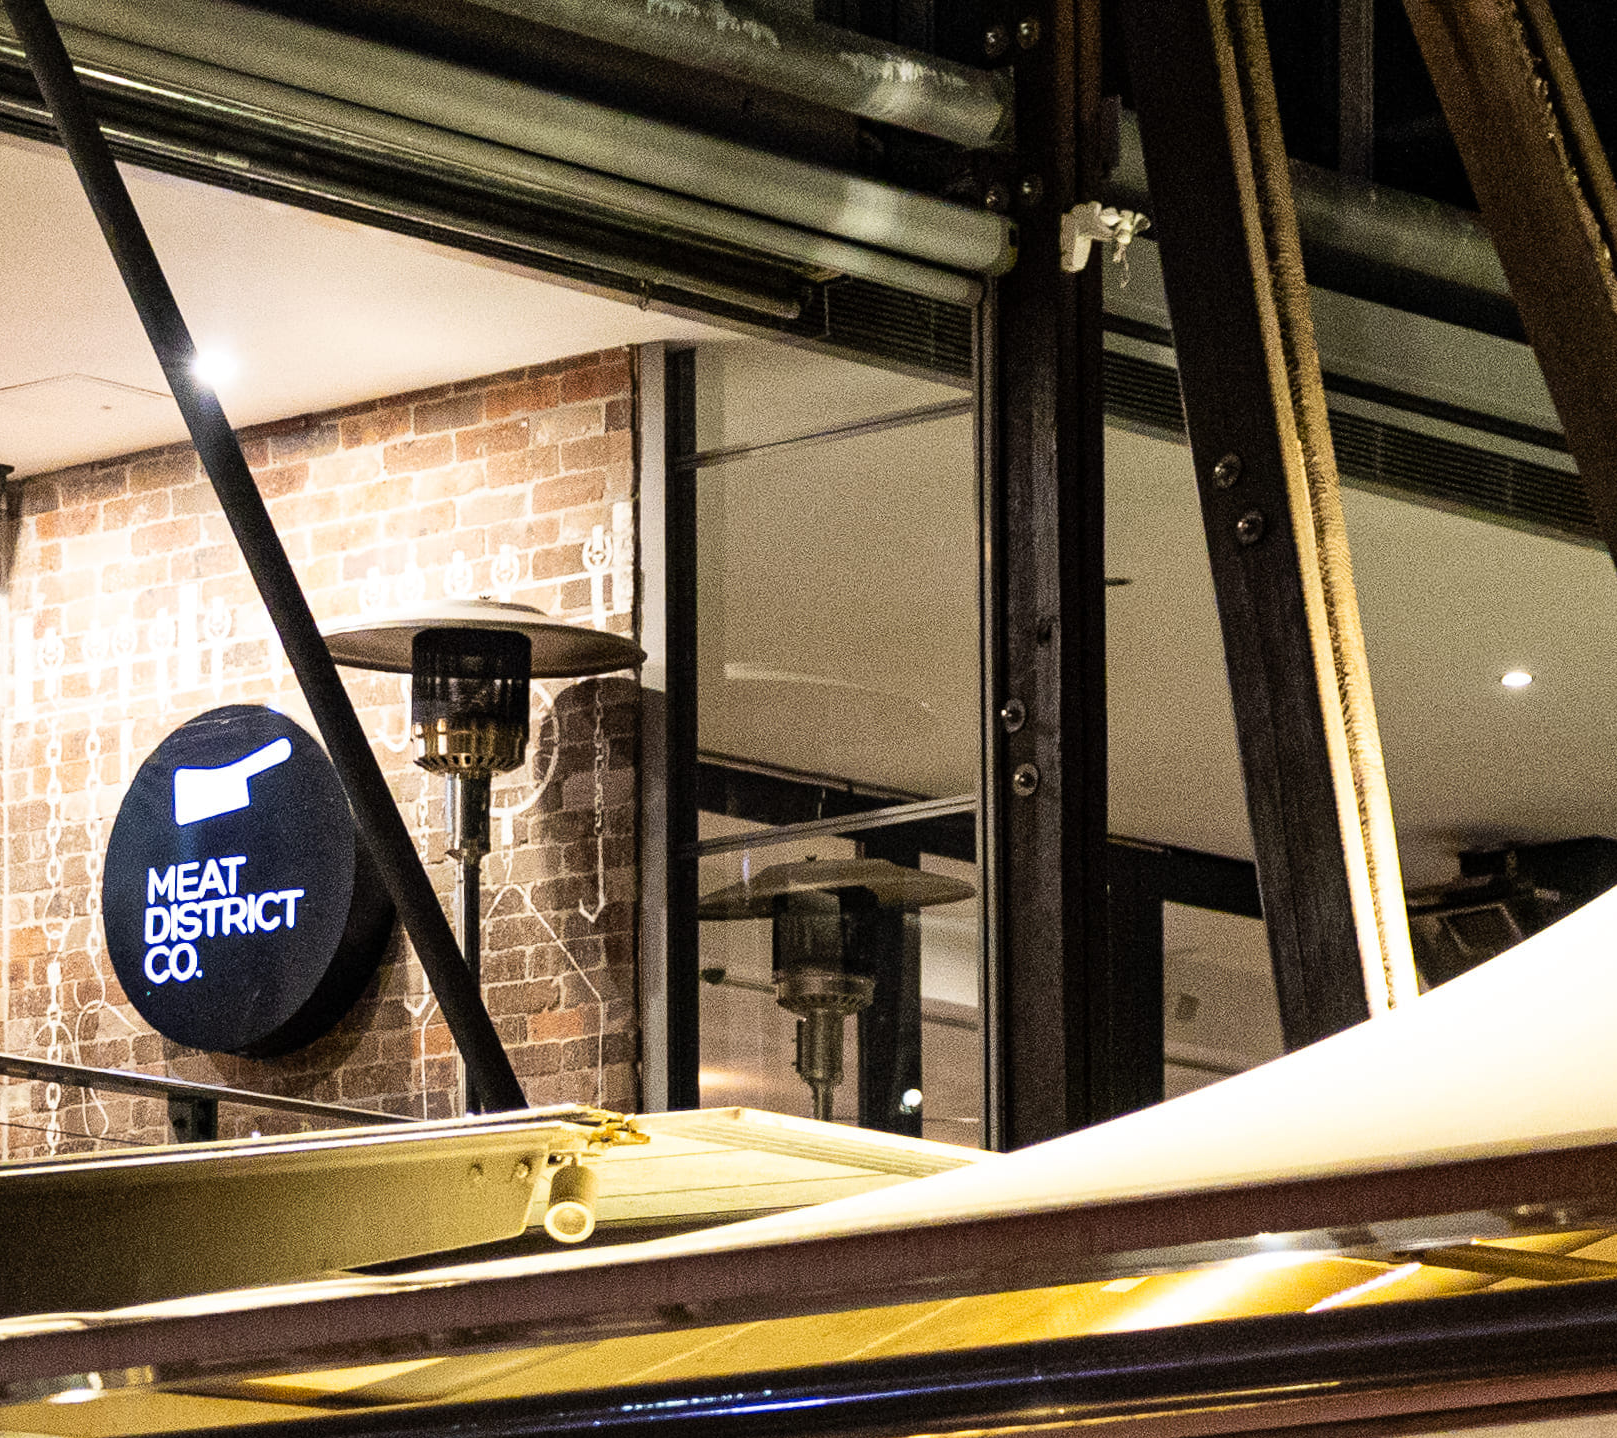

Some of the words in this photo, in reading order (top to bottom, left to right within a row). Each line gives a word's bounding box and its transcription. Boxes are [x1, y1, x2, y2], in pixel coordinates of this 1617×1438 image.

[146, 854, 248, 906] MEAT
[143, 888, 305, 945] DISTRICT
[143, 942, 203, 985] CO.
